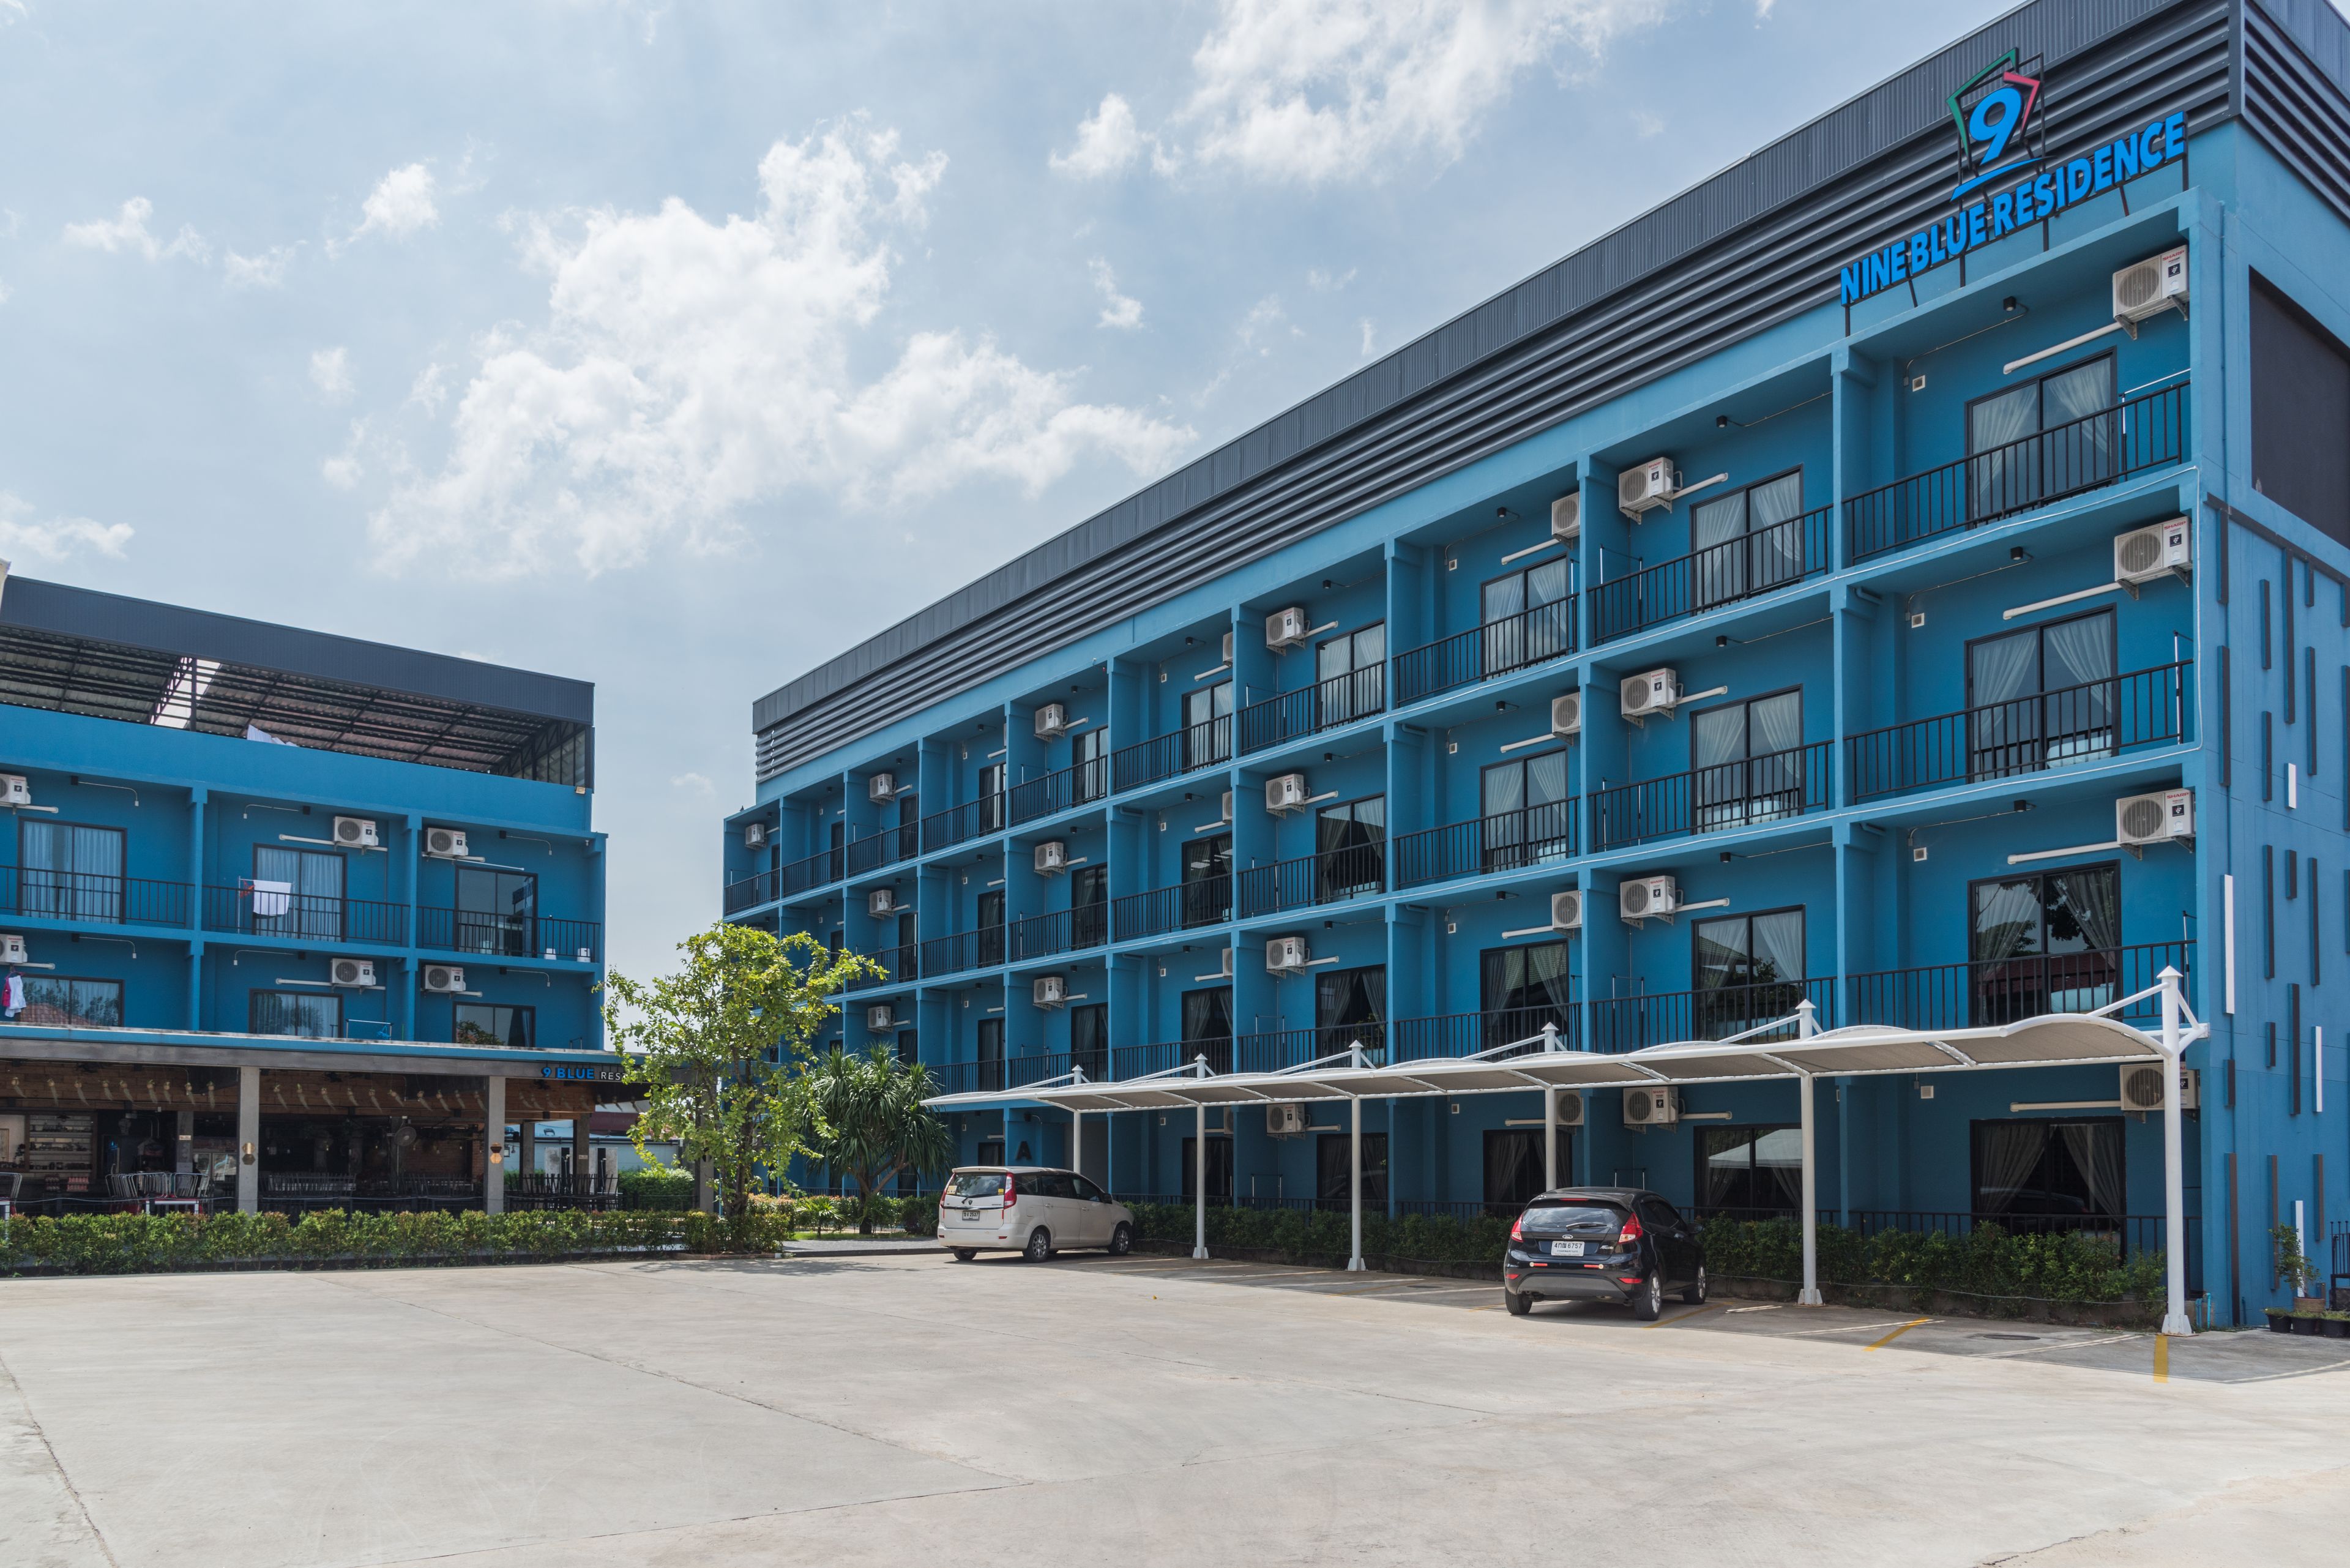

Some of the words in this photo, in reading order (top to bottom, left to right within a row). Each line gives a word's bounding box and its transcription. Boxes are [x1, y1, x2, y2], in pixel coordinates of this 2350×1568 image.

[1969, 87, 2024, 165] 9
[1840, 239, 1909, 305] NINE
[1910, 198, 1990, 275] BLUE
[1993, 111, 2188, 237] RESIDENCE
[2163, 250, 2185, 261] SHARP
[2164, 521, 2187, 530] SHARP
[542, 1067, 551, 1078] 9
[556, 1068, 595, 1080] BLUE
[1016, 1141, 1032, 1160] A
